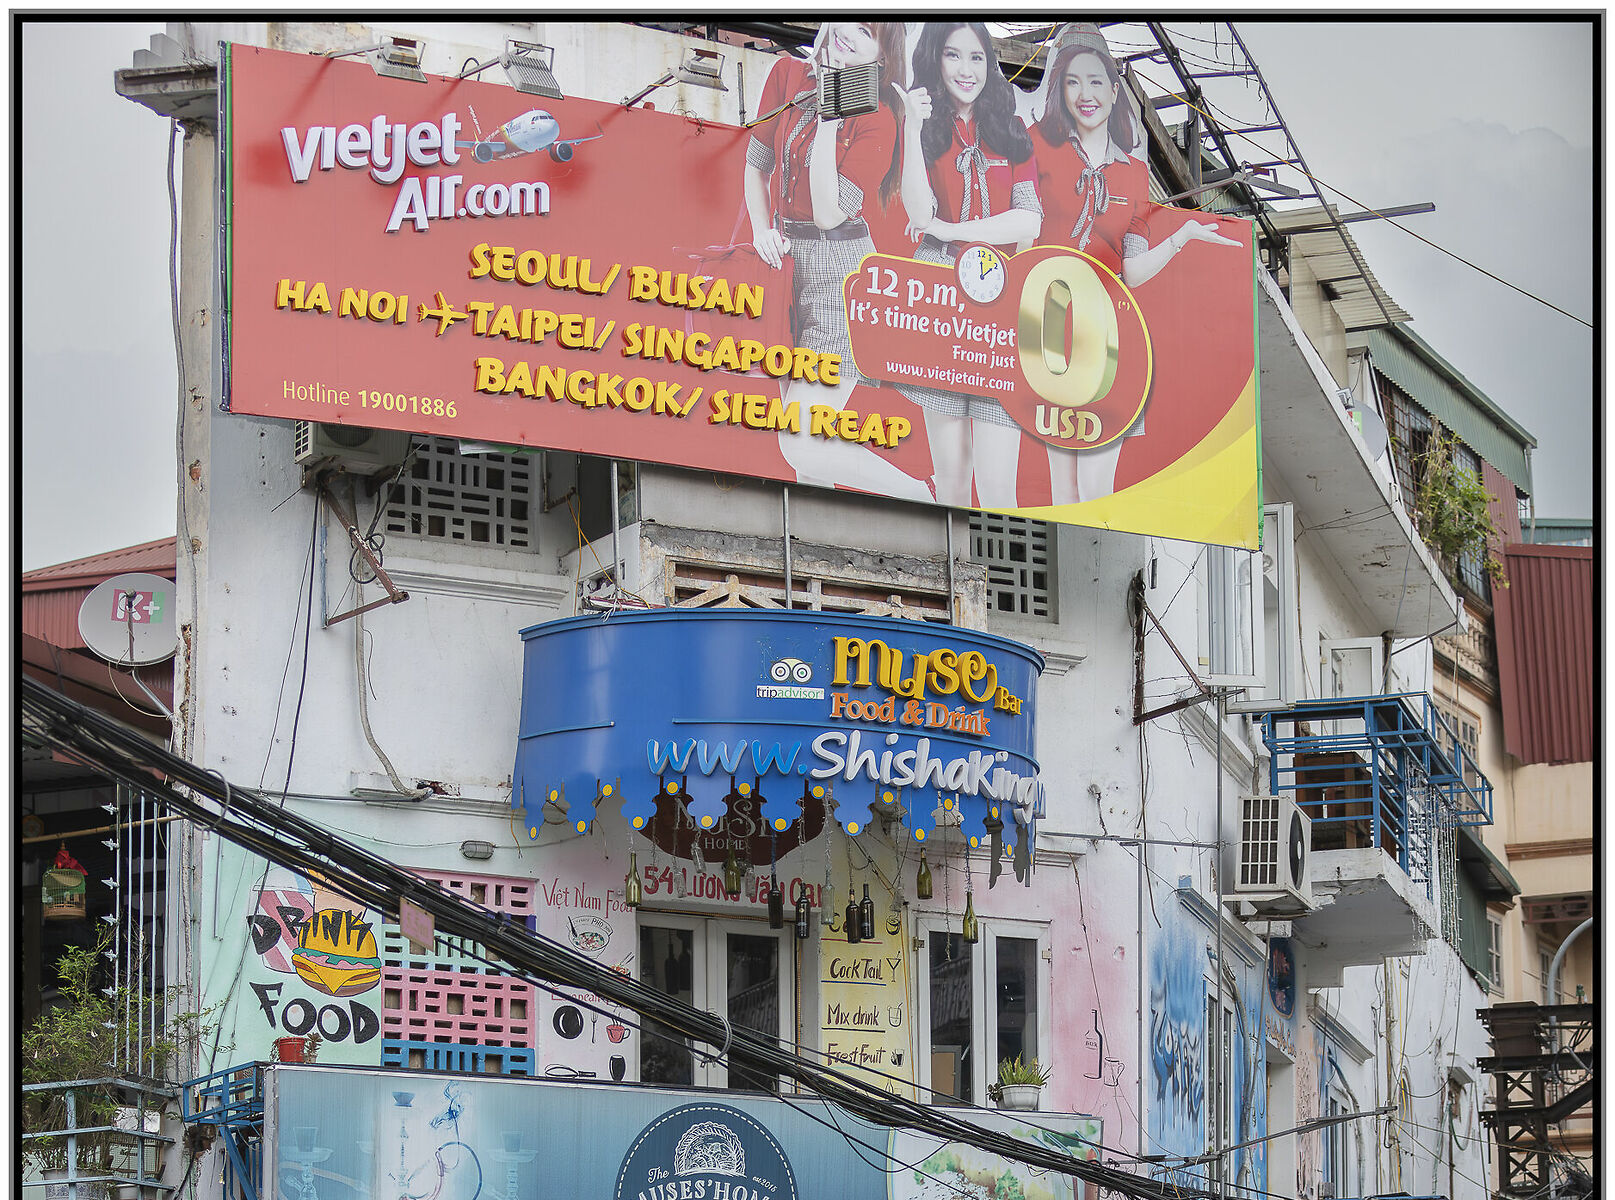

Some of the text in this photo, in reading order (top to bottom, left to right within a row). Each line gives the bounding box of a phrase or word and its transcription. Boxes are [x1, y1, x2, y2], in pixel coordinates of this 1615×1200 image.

[469, 243, 765, 320] SEOUL/ BUSAN
[864, 265, 964, 312] 12 p.m,
[276, 279, 410, 325] HA NOI
[849, 298, 880, 325] It's
[884, 308, 930, 333] time
[950, 316, 1017, 349] Vietjet
[468, 301, 843, 387] TAIPEI/ SINGAPORE
[952, 345, 1017, 370] From just
[886, 359, 1016, 393] www.vietjetair.com
[283, 380, 459, 420] Hotline 19001886
[473, 357, 912, 449] BANGKOK/ SIEM REAP
[1034, 403, 1103, 443] USD
[830, 692, 992, 737] Food & Drink
[993, 685, 1024, 716] Bar
[574, 882, 601, 910] Nam
[644, 866, 674, 895] 54
[249, 981, 380, 1044] FOOD
[852, 1005, 880, 1026] drink
[647, 1167, 669, 1184] The
